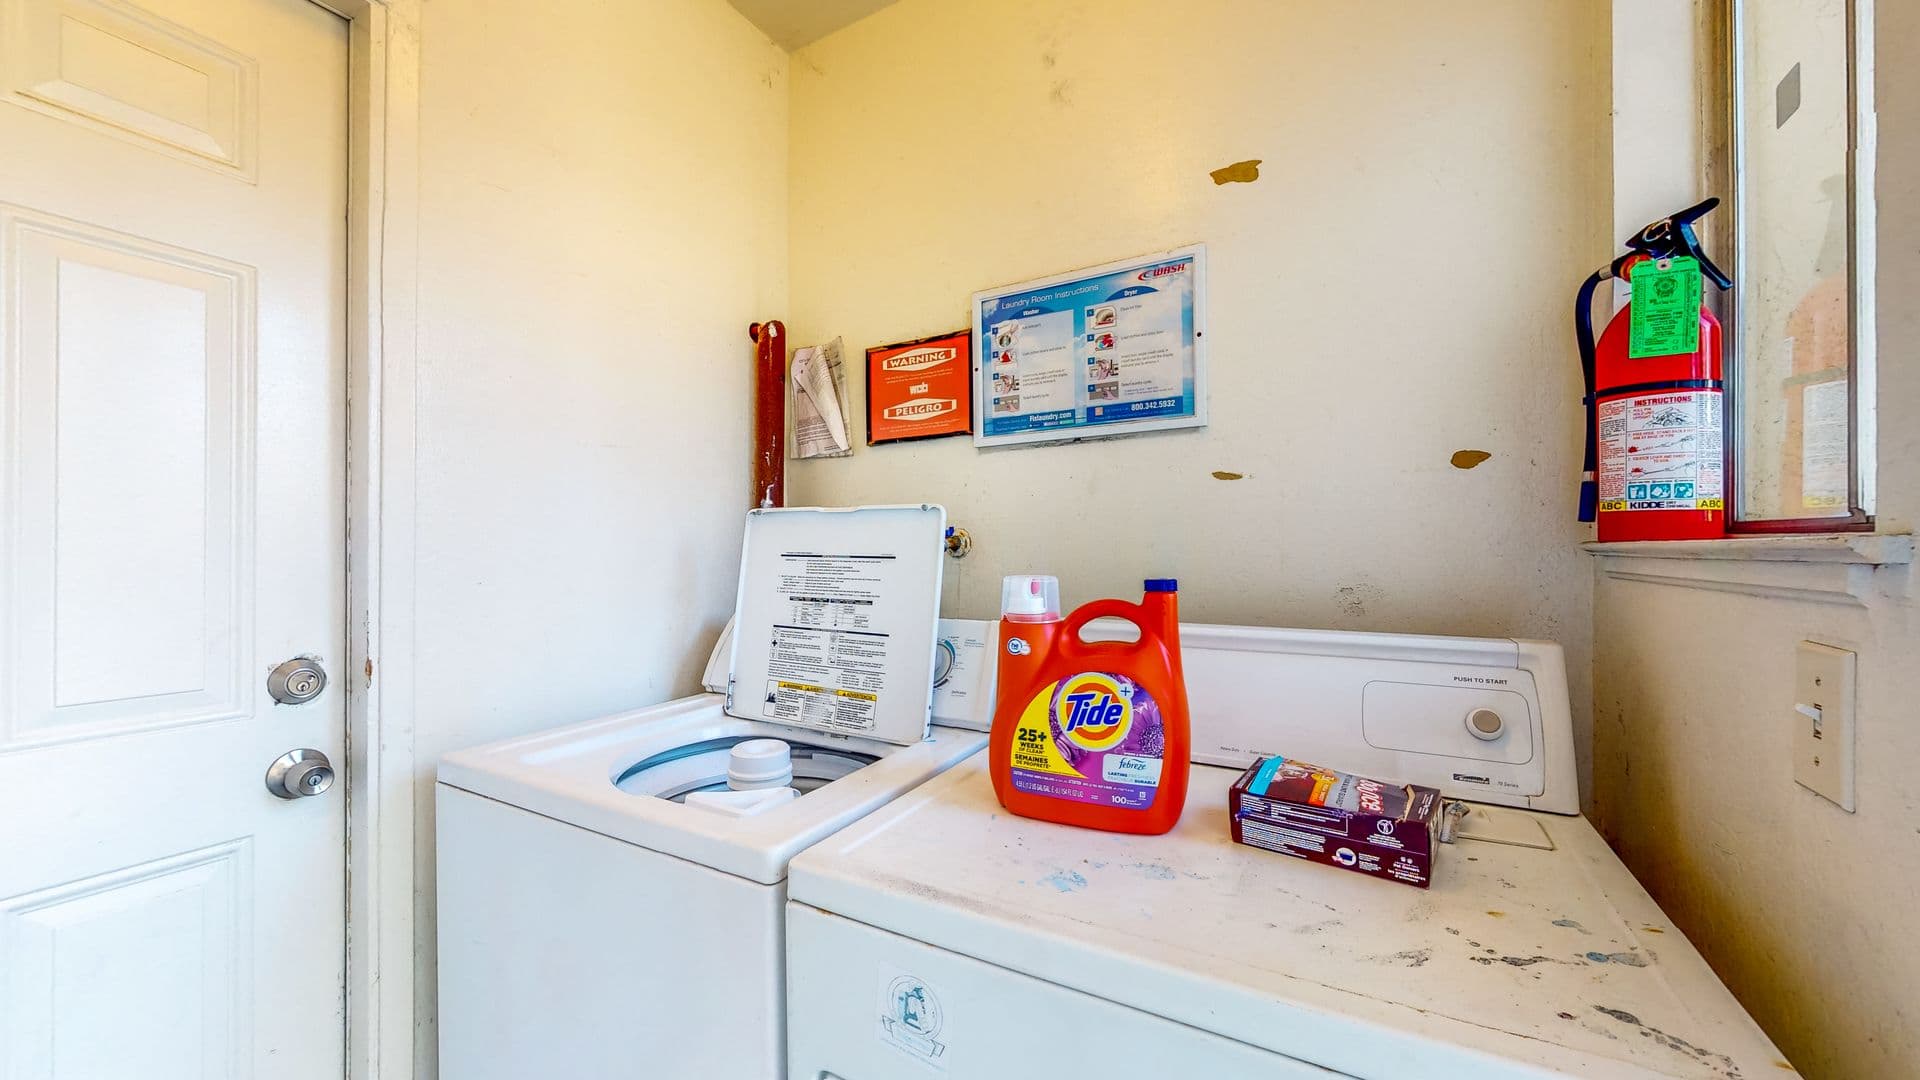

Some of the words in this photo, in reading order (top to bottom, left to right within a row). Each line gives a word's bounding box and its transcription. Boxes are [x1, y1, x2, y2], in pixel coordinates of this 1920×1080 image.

[1153, 263, 1186, 277] WASH
[1001, 298, 1030, 310] Laundry
[1031, 294, 1053, 304] Room
[1054, 284, 1099, 299] Instructions
[889, 351, 946, 368] WARNING
[1634, 395, 1692, 407] INSTRUCTIONS
[895, 403, 942, 417] PELIGRO
[1601, 502, 1622, 510] ABC
[1630, 501, 1665, 509] KIDDE
[1066, 693, 1124, 732] Tide
[1018, 727, 1047, 742] 25+
[1020, 742, 1044, 750] WEEKS
[1014, 753, 1049, 764] SEMAINES
[1118, 757, 1147, 771] febreze
[1111, 795, 1127, 804] 100
